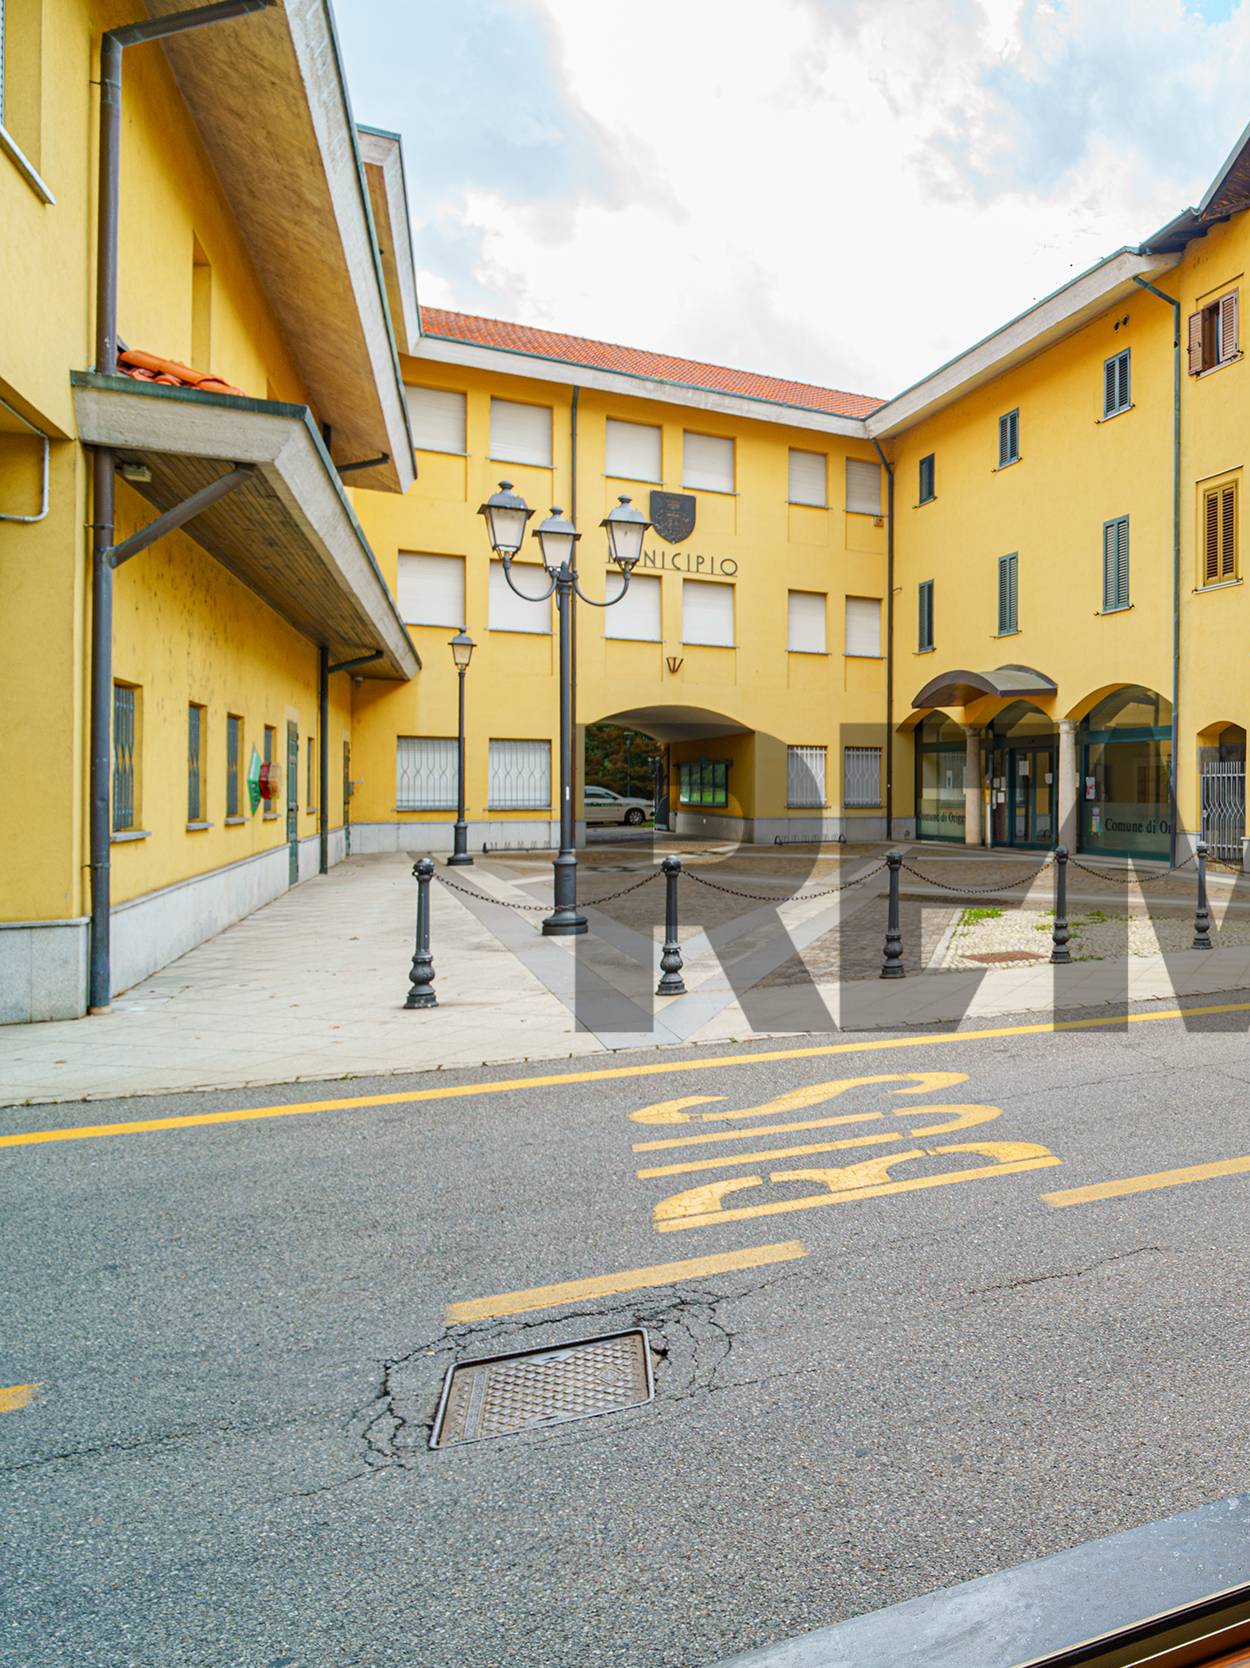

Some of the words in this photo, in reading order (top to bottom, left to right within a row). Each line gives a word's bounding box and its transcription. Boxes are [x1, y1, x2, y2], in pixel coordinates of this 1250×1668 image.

[608, 545, 738, 576] NICIPIO
[1105, 818, 1143, 833] Comune
[1146, 819, 1156, 834] di
[628, 1071, 1062, 1232] BUS
